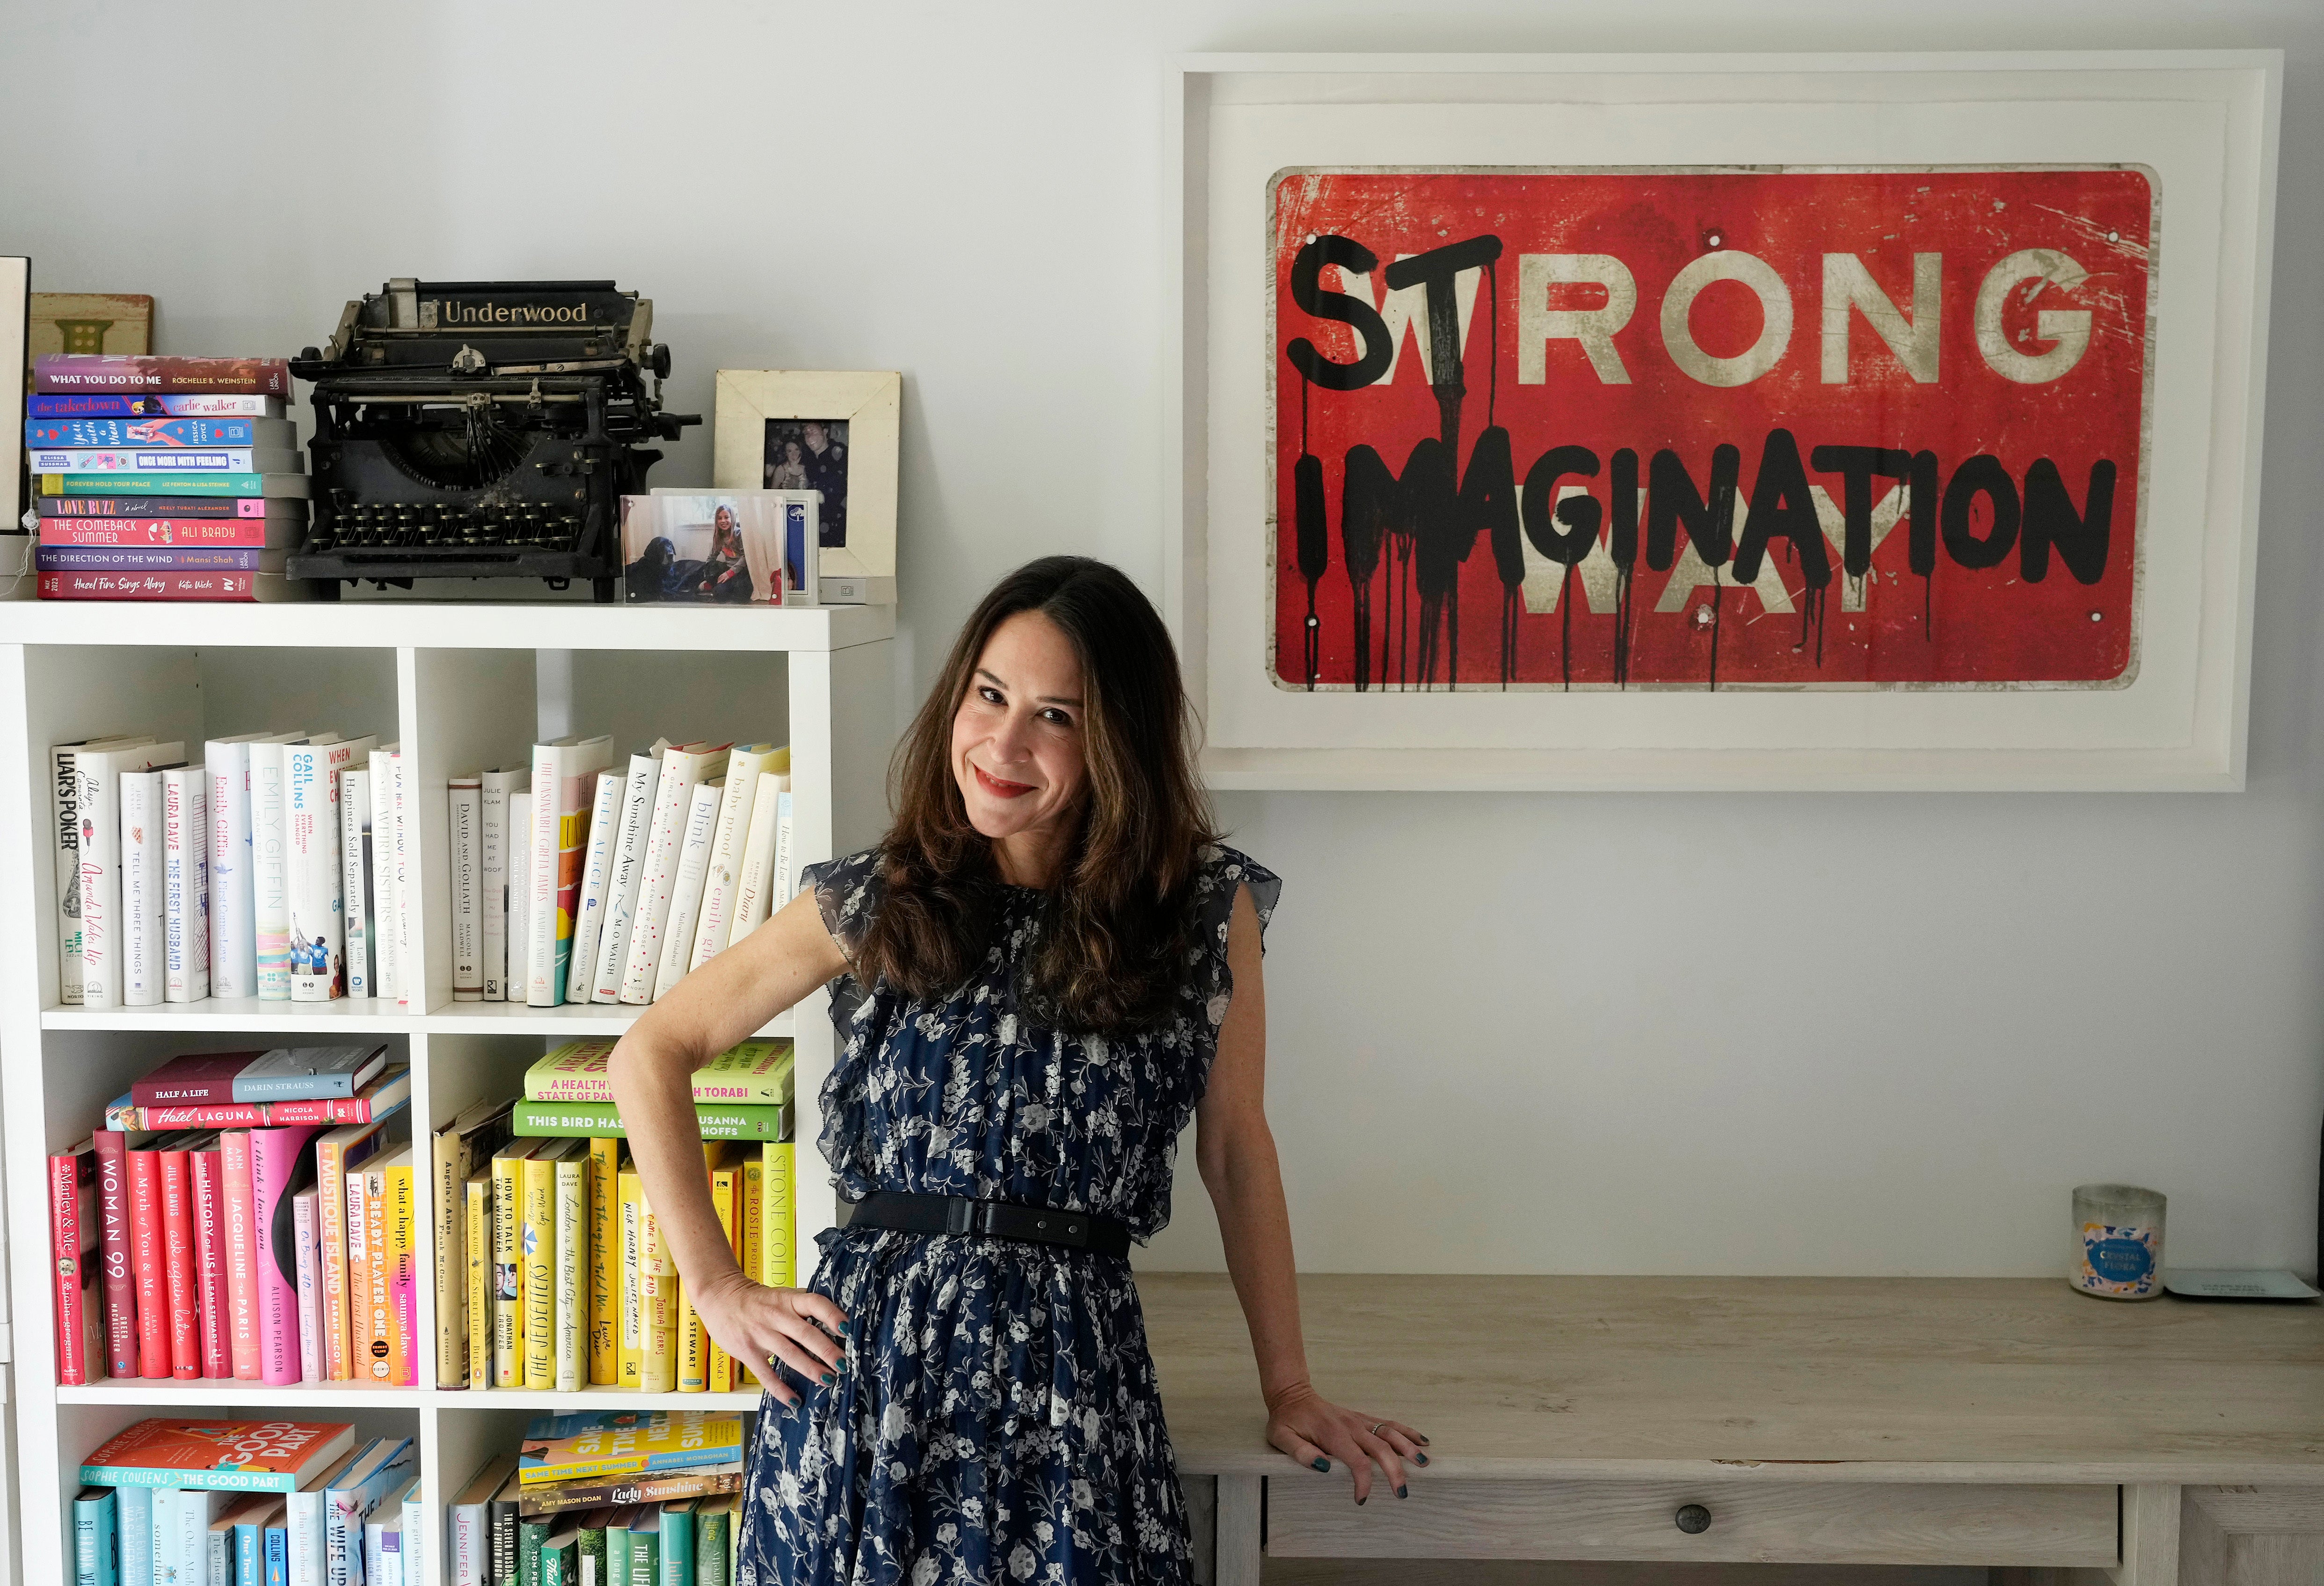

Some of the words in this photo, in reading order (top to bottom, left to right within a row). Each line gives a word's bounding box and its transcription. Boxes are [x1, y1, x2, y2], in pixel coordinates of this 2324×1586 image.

[445, 300, 586, 322] Underwood
[1286, 233, 2092, 391] STRONG
[50, 375, 81, 384] WHAT
[146, 376, 161, 385] ME
[38, 403, 52, 412] the
[55, 398, 120, 412] takedown
[174, 399, 200, 412] carlie
[203, 400, 237, 412] walker
[86, 421, 98, 444] with
[108, 421, 120, 445] View
[139, 456, 156, 466] ONCE
[157, 456, 176, 466] MORE
[177, 456, 195, 466] WITH
[197, 456, 227, 466] FEELING
[57, 500, 86, 514] LOVE
[88, 500, 116, 514] BUZZ
[1293, 427, 2116, 586] IMAGINATION
[53, 520, 72, 530] THE
[76, 520, 137, 531] COMEBACK
[73, 532, 118, 543] SUMMER
[182, 526, 197, 538] ALI
[202, 527, 235, 538] BRADY
[74, 577, 98, 589] Hazel
[99, 577, 116, 589] Fine
[118, 577, 140, 593] Sings
[143, 577, 166, 593] Along
[179, 580, 193, 589] Katie
[195, 580, 212, 589] Wicks
[57, 753, 76, 797] LIAR'S
[293, 754, 303, 809] COLLINS
[304, 754, 313, 783] GAIL
[633, 772, 647, 793] My
[168, 783, 178, 819] LAURA
[214, 776, 227, 816] Emily
[346, 778, 356, 832] Happiness
[59, 801, 79, 849] POKER
[168, 819, 179, 850] DAVE
[460, 804, 471, 838] DAVID
[625, 795, 646, 851] Sunshine
[690, 802, 713, 849] blink
[216, 819, 228, 857] Giffin
[169, 859, 180, 878] THE
[616, 855, 635, 888] Away
[133, 881, 140, 896] ME
[169, 879, 180, 913] FIRST
[349, 862, 358, 914] Separately
[462, 863, 472, 914] GOLIATH
[706, 888, 723, 932] emily
[169, 914, 181, 970] HUSBAND
[244, 1083, 273, 1091] DARIN
[276, 1082, 314, 1090] STRAUSS
[705, 1088, 748, 1097] TORABI
[158, 1107, 197, 1124] Hotel
[198, 1111, 254, 1121] LAGUNA
[527, 1116, 557, 1126] THIS
[562, 1117, 594, 1127] BIRD
[598, 1118, 624, 1128] HAS
[699, 1116, 746, 1126] USANNA
[397, 1178, 409, 1205] what
[496, 1177, 502, 1189] TO
[771, 1155, 786, 1220] STONE
[102, 1158, 121, 1242] WOMAN
[322, 1159, 338, 1237] MUSTIQUE
[350, 1183, 360, 1218] LAURA
[369, 1200, 383, 1248] READY
[505, 1207, 512, 1219] TO
[169, 1230, 185, 1258] ask
[232, 1197, 247, 1279] JACQUELINE
[350, 1221, 361, 1248] DAVE
[395, 1217, 409, 1255] happy
[106, 1253, 125, 1279] 99
[326, 1241, 342, 1294] ISLAND
[399, 1253, 410, 1288] family
[771, 1228, 787, 1285] COLD
[167, 1261, 184, 1304] again
[371, 1251, 385, 1304] PLAYER
[169, 1309, 190, 1345] later
[237, 1298, 249, 1339] PARIS
[373, 1308, 386, 1337] ONE
[81, 1469, 118, 1483] SOPHIE
[122, 1471, 168, 1484] COUSENS
[183, 1474, 204, 1485] THE
[207, 1475, 249, 1487] GOOD
[252, 1476, 280, 1488] PART
[525, 1470, 549, 1478] SAME
[551, 1467, 574, 1476] TIME
[601, 1461, 637, 1470] SUMMER
[583, 1495, 602, 1503] DOAN
[611, 1487, 643, 1505] Lady
[643, 1481, 704, 1498] Sunshine
[271, 1534, 280, 1562] COLLINS
